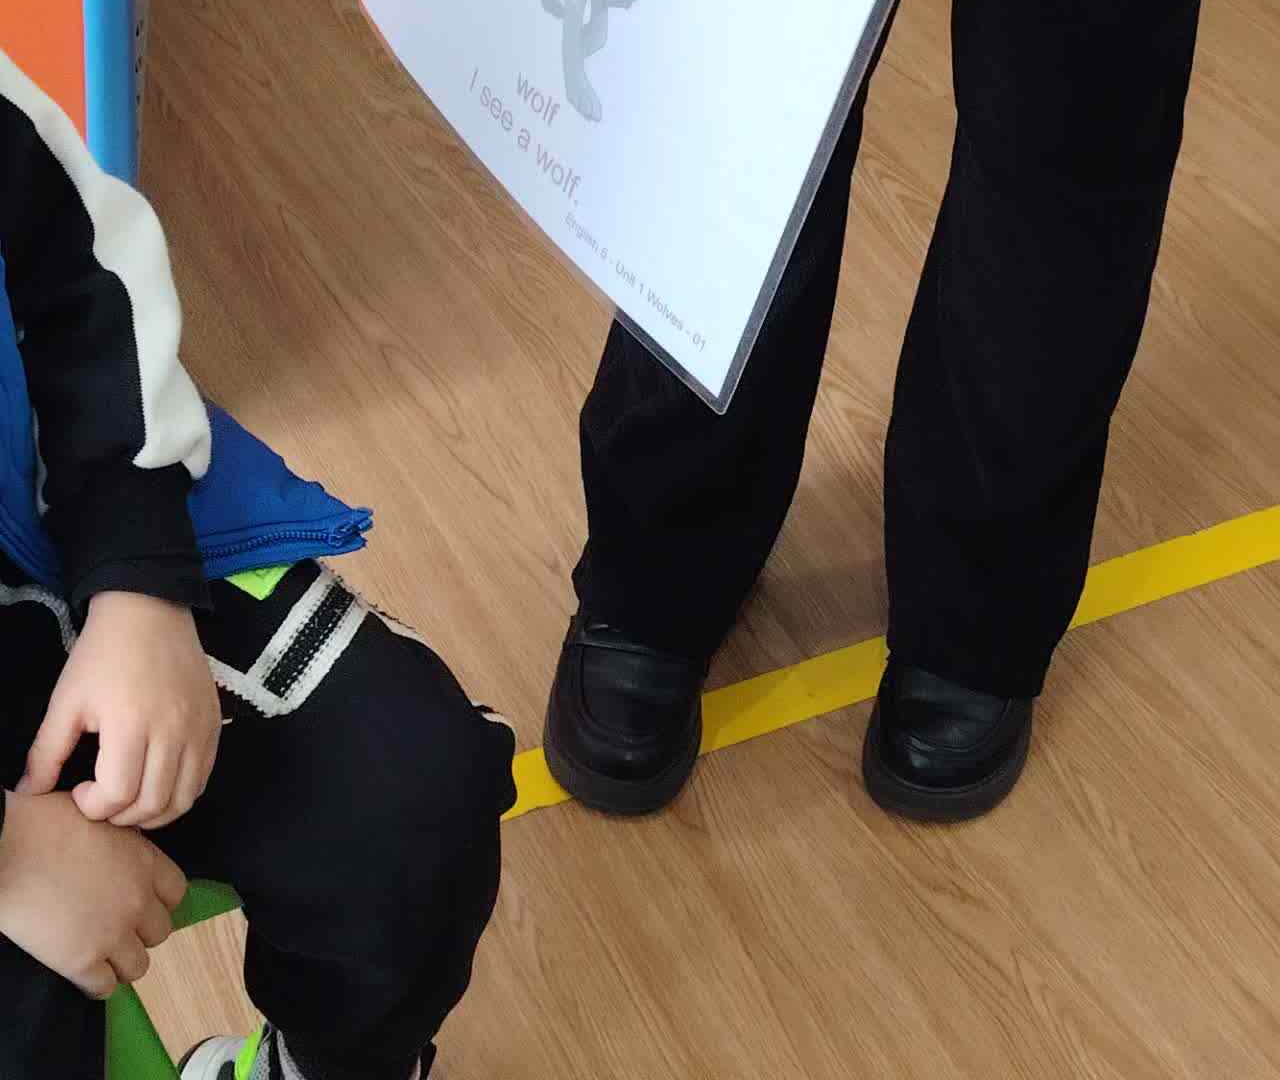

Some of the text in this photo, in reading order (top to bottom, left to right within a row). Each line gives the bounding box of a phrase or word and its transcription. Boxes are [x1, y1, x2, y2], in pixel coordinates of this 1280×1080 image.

[517, 72, 560, 126] wolf
[469, 67, 581, 206] I see a wolf.
[615, 261, 636, 287] Unit
[647, 287, 683, 331] Wolves
